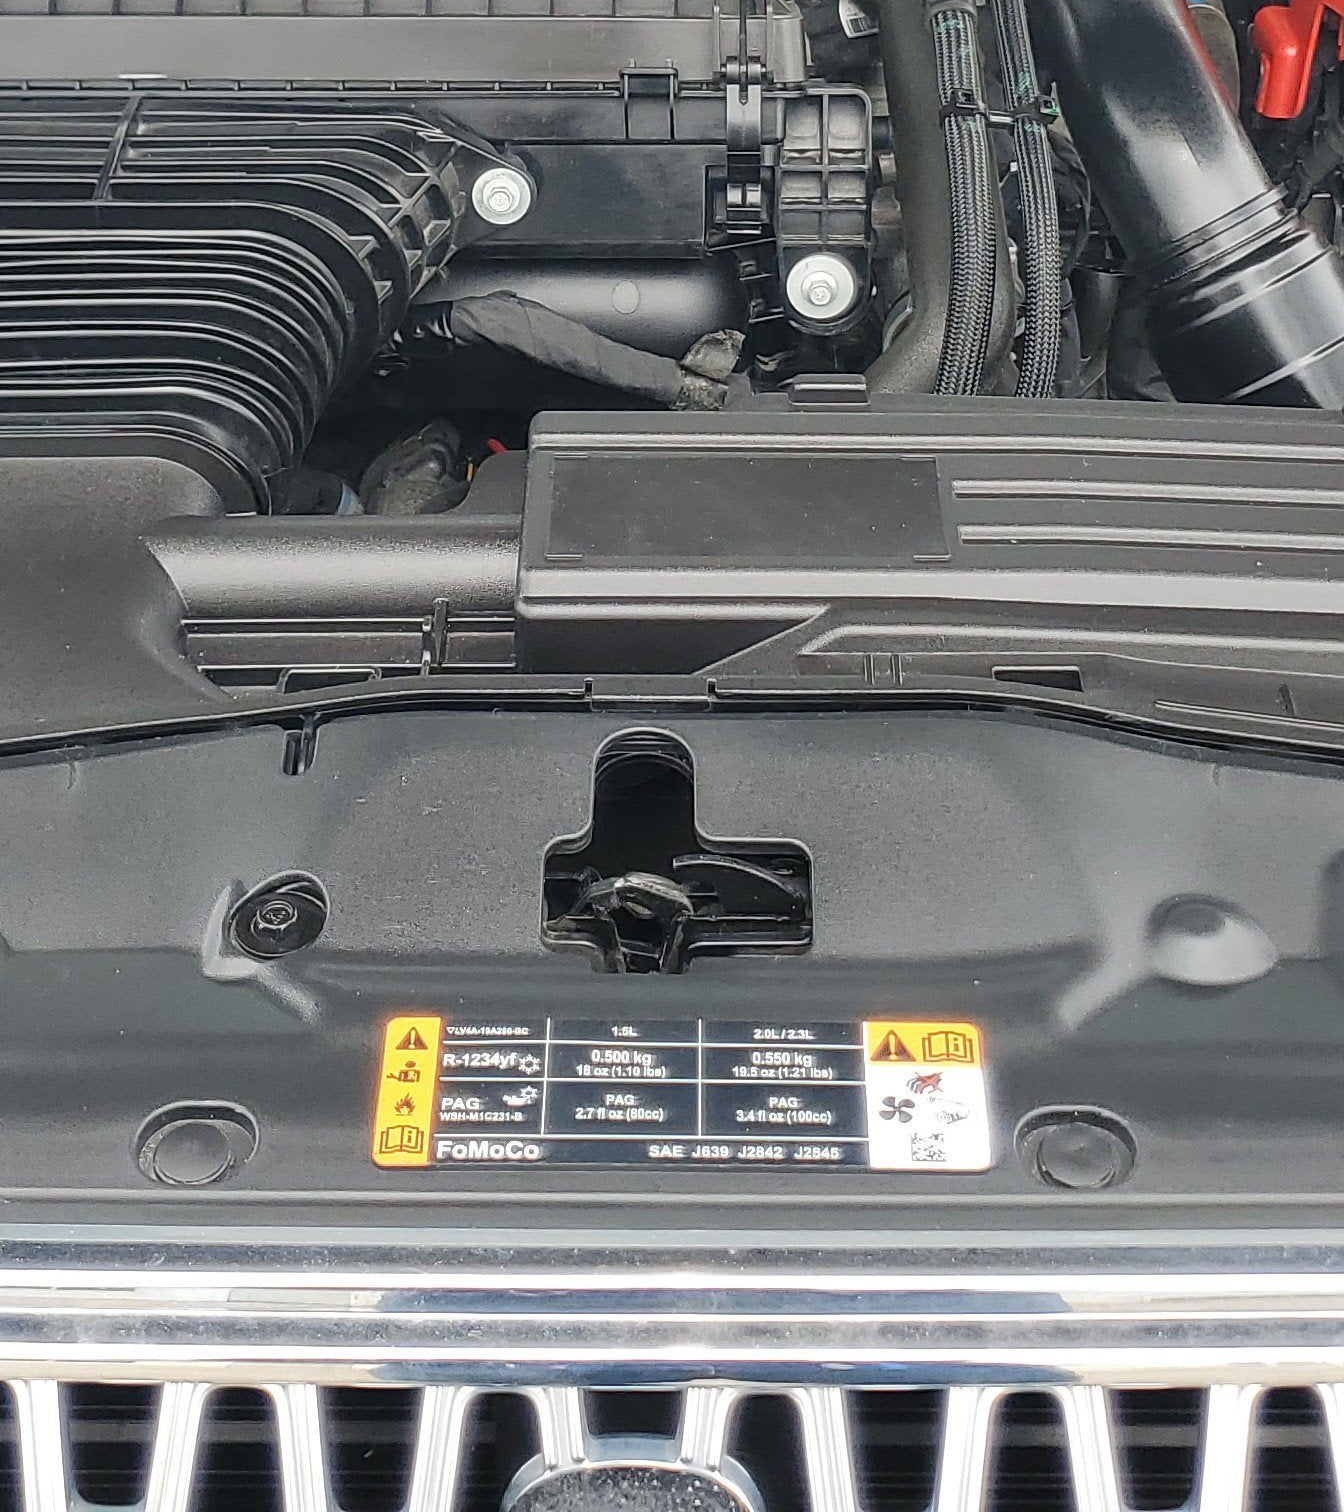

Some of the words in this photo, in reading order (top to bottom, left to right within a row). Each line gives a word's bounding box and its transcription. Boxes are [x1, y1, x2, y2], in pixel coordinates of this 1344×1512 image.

[611, 1026, 638, 1037] 1.5L
[753, 1028, 779, 1039] 2.0L
[788, 1029, 813, 1039] 2.3L
[442, 1052, 518, 1069] R-1234yf
[591, 1049, 630, 1063] 0.500
[633, 1050, 652, 1066] kg
[752, 1052, 791, 1065] 0.550
[794, 1052, 813, 1067] kg
[593, 1066, 609, 1076] oz
[611, 1065, 640, 1077] (1.10
[643, 1065, 666, 1078] lbs)
[732, 1066, 758, 1077] 19.5
[760, 1068, 776, 1077] oz
[778, 1067, 806, 1079] (1.21
[810, 1067, 833, 1079] lbs)
[441, 1097, 480, 1110] PAG
[605, 1094, 635, 1105] PAG
[769, 1097, 798, 1108] PAG
[575, 1107, 594, 1119] 2.7
[596, 1108, 606, 1119] fl
[608, 1110, 624, 1119] oz
[736, 1110, 756, 1122] 3.4
[757, 1110, 766, 1122] fl
[768, 1112, 784, 1121] oz
[787, 1110, 832, 1124] (100cc)
[436, 1140, 540, 1160] FoMoCo
[648, 1145, 684, 1157] SAE
[692, 1145, 729, 1158] J639
[738, 1146, 783, 1158] J2842
[794, 1146, 840, 1159] J2845
